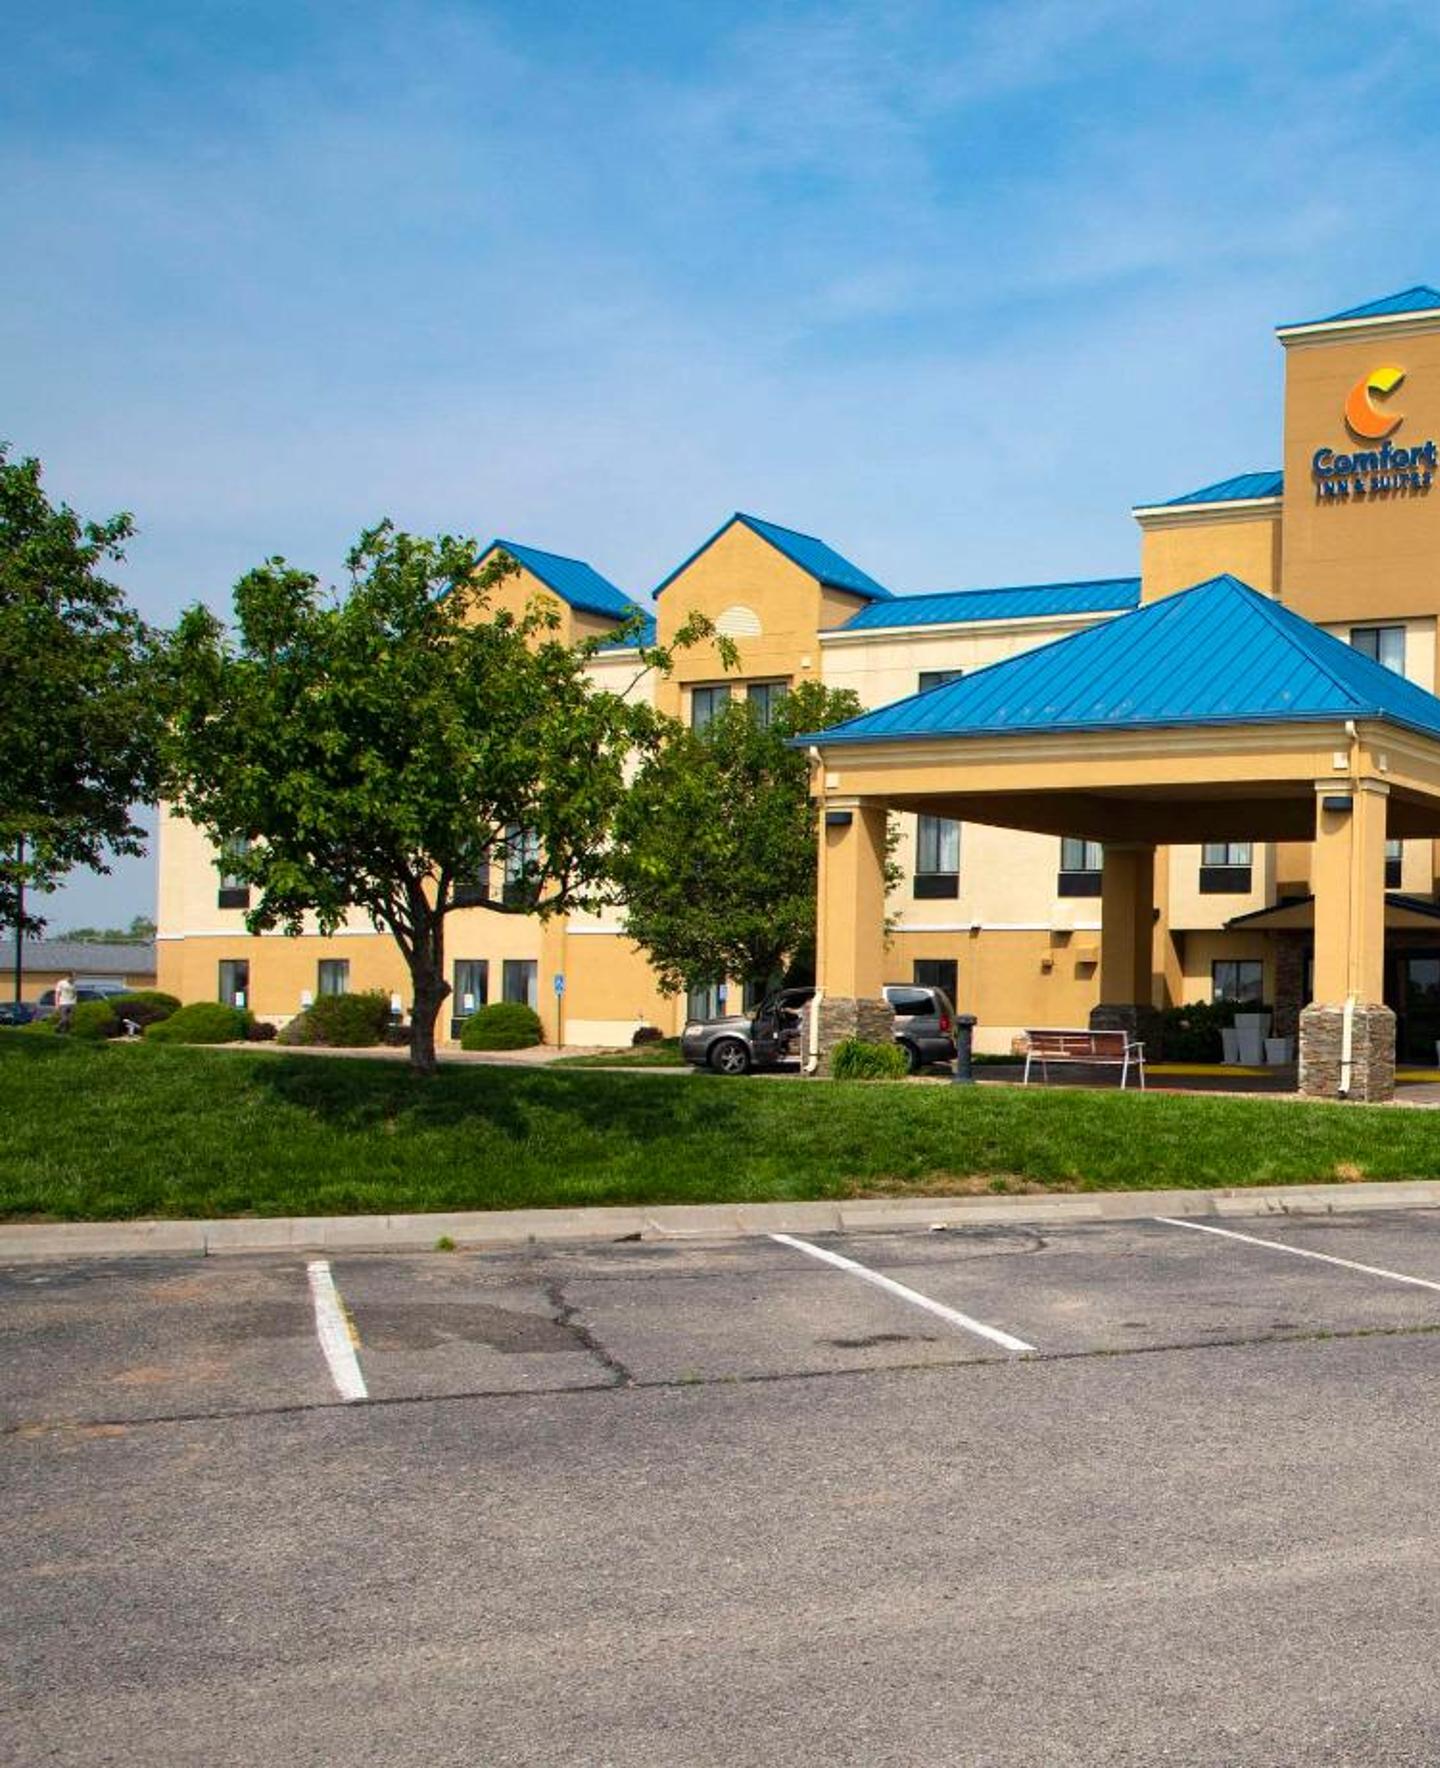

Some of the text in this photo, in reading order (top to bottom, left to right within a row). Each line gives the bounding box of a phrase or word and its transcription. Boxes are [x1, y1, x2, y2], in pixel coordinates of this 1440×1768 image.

[1313, 440, 1437, 477] Comfort
[1317, 479, 1348, 498] INN
[1371, 471, 1432, 492] SUITES
